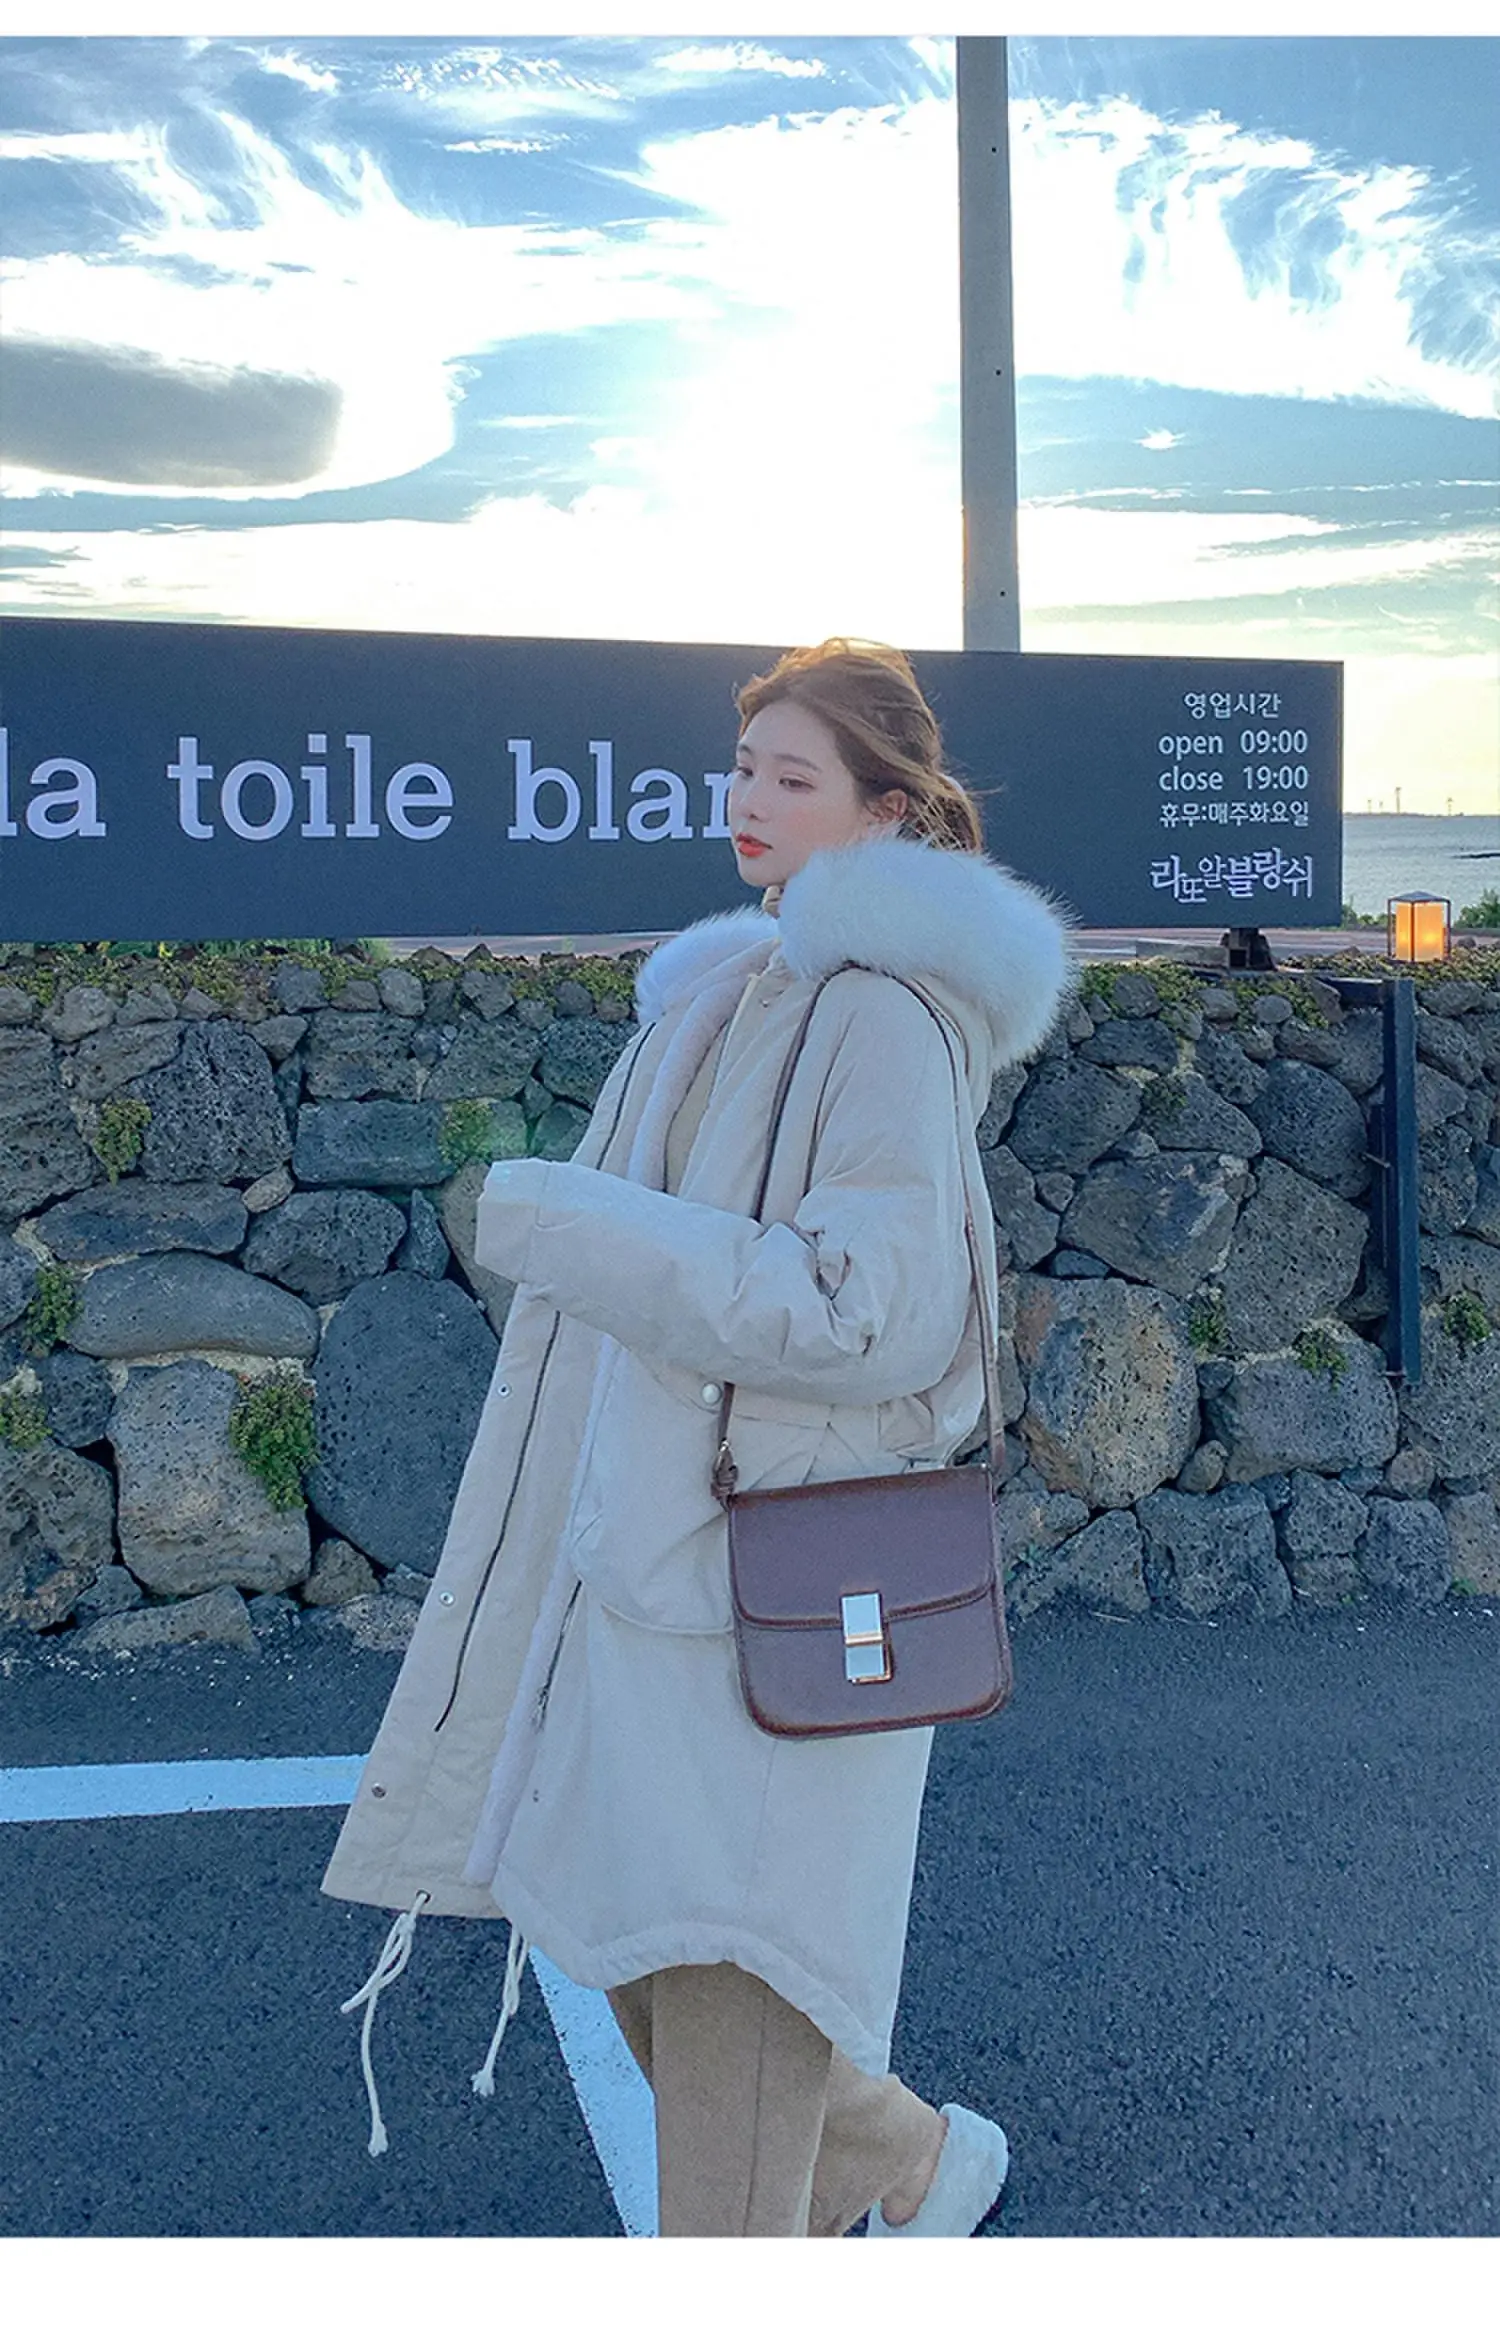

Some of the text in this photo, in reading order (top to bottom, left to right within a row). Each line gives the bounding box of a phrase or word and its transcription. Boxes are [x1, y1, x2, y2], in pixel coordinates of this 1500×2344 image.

[1183, 692, 1282, 720] 영업시간
[1158, 729, 1308, 761] open 09:00
[166, 733, 454, 841] toile
[1158, 765, 1310, 791] close 19:00
